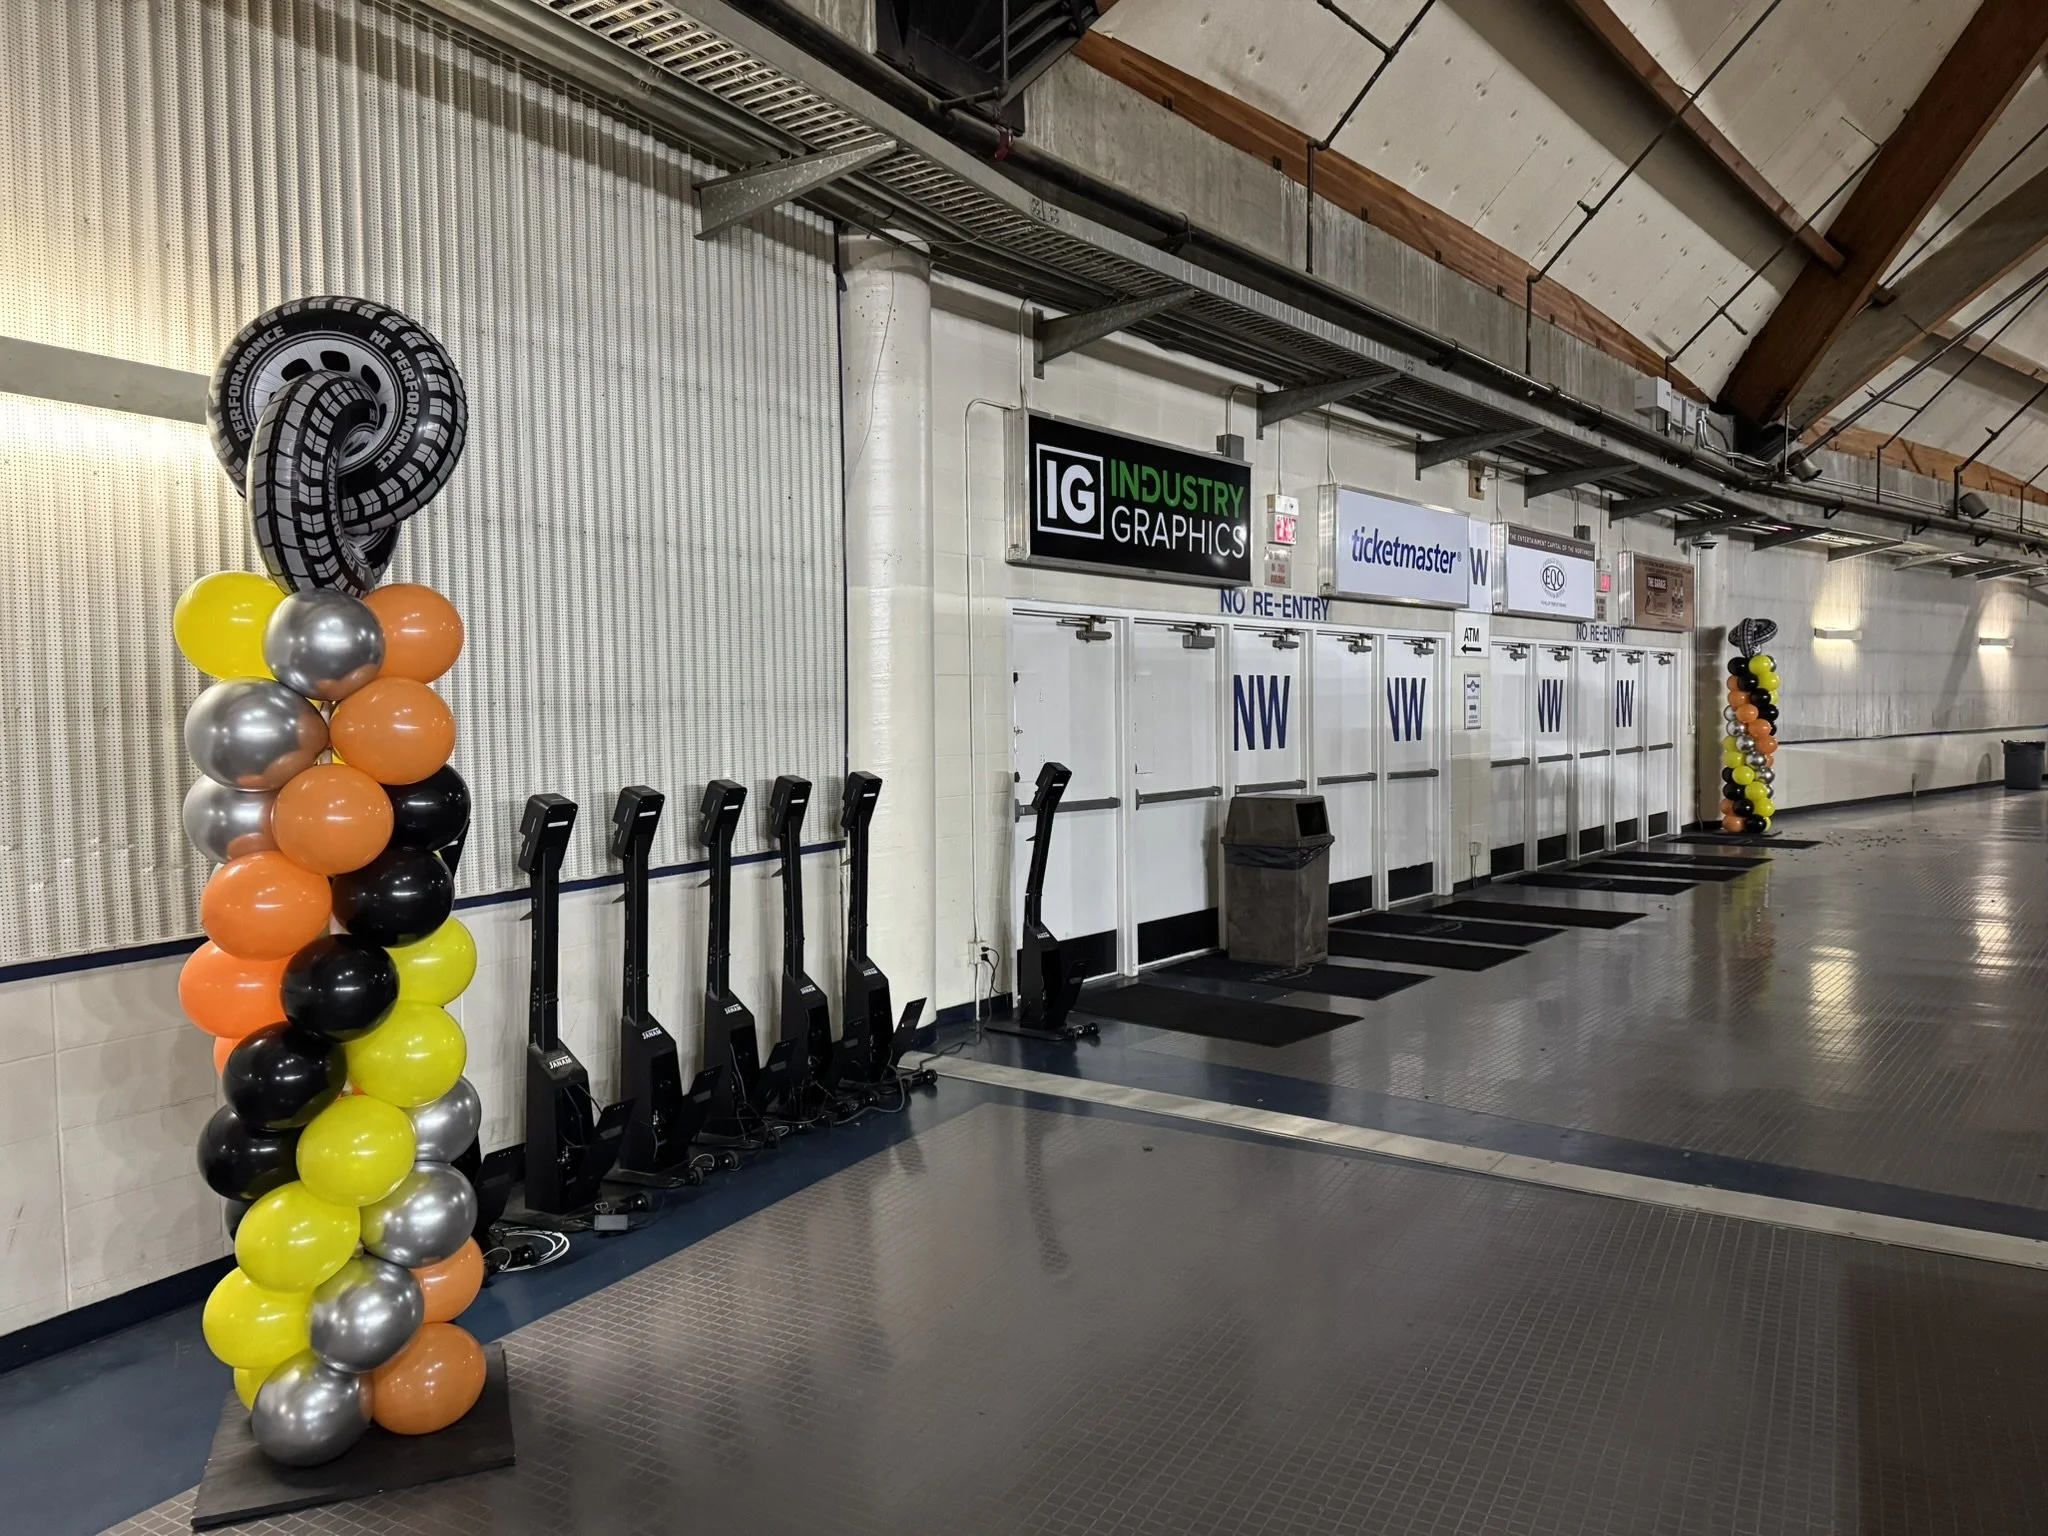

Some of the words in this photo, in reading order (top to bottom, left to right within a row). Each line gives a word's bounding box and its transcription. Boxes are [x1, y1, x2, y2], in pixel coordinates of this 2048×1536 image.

[369, 330, 391, 350] HI
[228, 325, 286, 442] PERFORMANCE
[377, 350, 420, 472] PERFORMANCE
[1046, 459, 1096, 524] IG
[1111, 459, 1245, 518] INDUSTRY
[1111, 505, 1246, 559] GRAPHICS
[1221, 588, 1246, 614] NO
[1253, 591, 1330, 620] RE-ENTRY
[1464, 627, 1480, 642] ATM
[1576, 623, 1588, 641] NO
[1590, 624, 1626, 643] RE-ENTRY
[1233, 675, 1291, 751] NW
[641, 1027, 663, 1040] JANAM
[549, 1055, 573, 1069] JANAM
